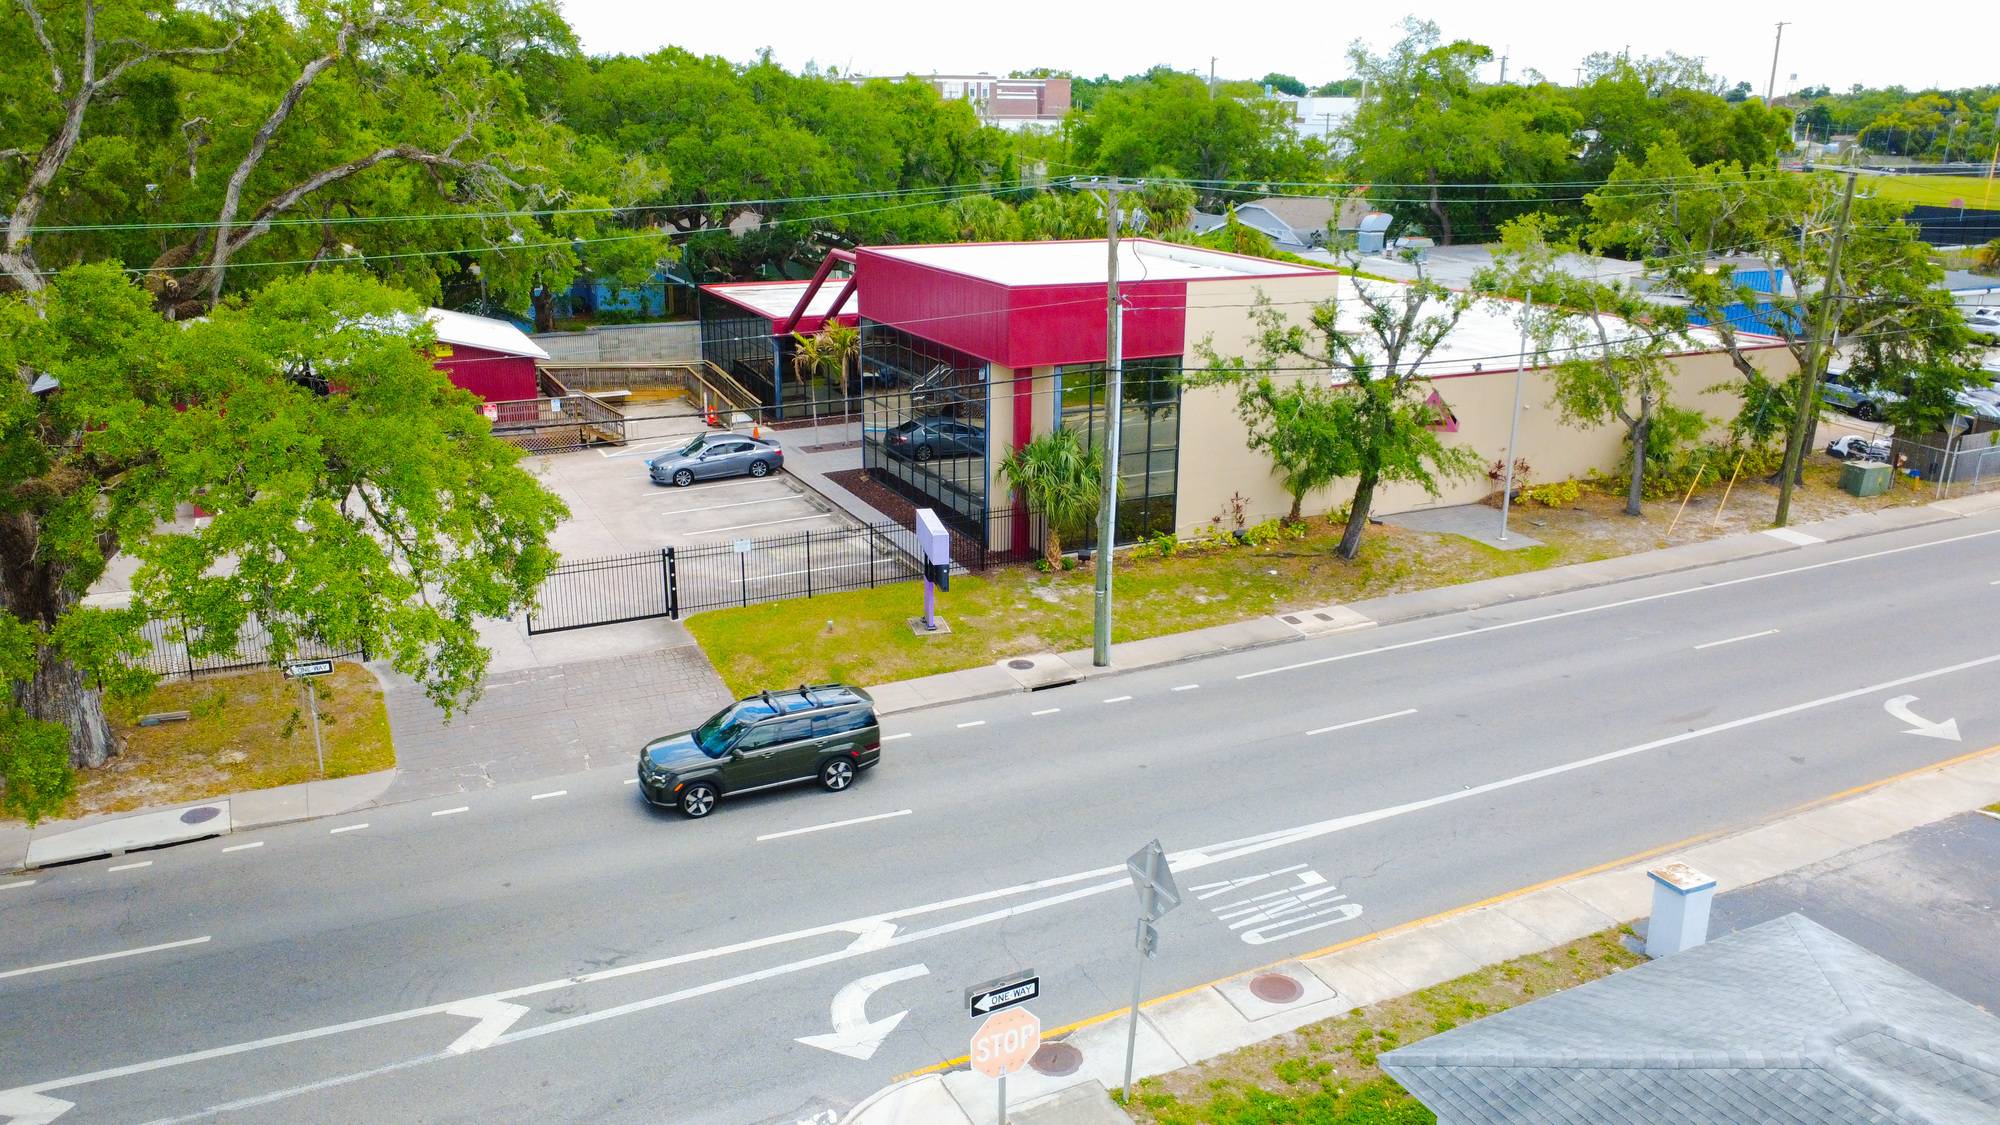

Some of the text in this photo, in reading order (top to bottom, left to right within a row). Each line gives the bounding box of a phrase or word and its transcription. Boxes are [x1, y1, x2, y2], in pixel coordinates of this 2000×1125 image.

[1187, 862, 1364, 945] ONLY
[991, 985, 1032, 1004] ONE WAY
[976, 1024, 1034, 1062] STOP
